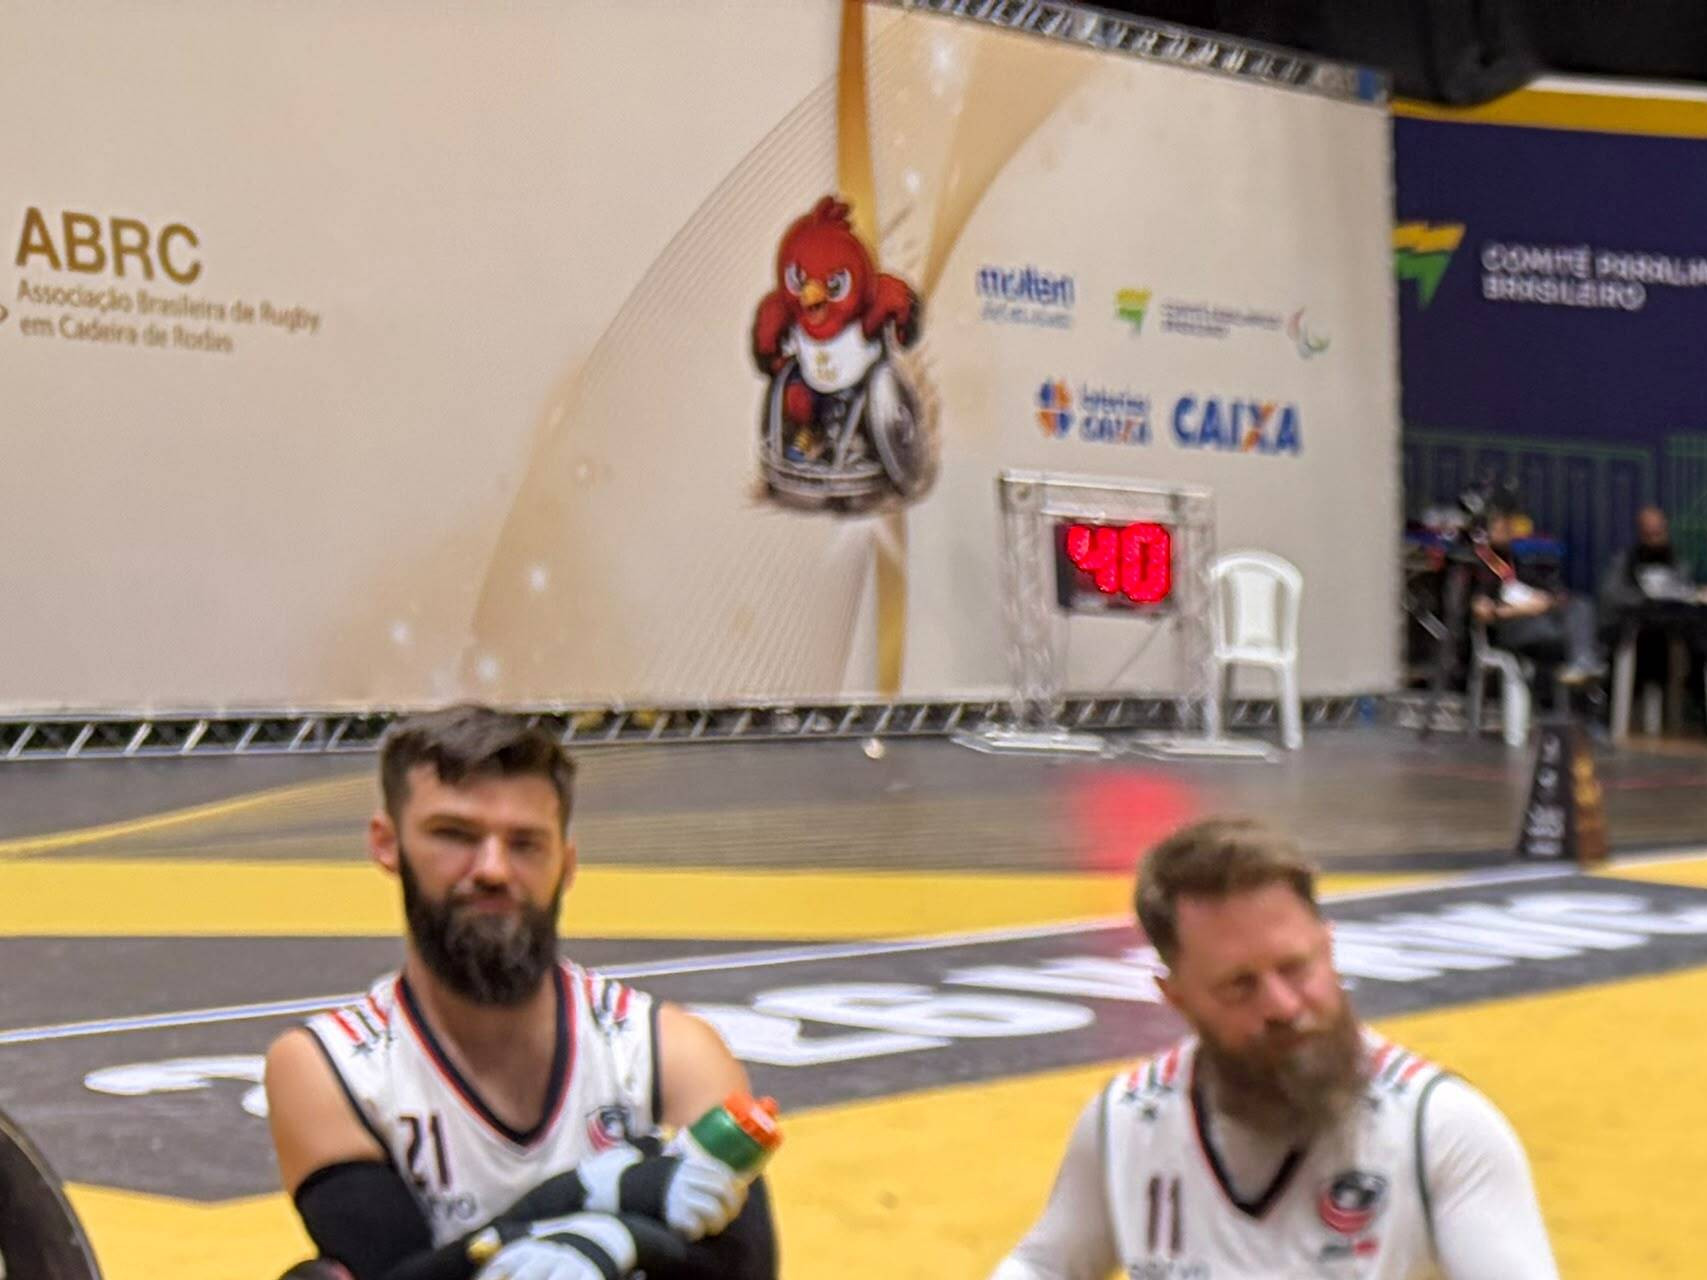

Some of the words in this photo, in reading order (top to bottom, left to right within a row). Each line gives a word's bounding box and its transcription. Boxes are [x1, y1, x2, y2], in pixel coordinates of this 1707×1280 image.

[15, 206, 203, 285] ABRC
[1172, 395, 1303, 454] CAIXA
[1066, 522, 1171, 603] 40
[398, 1113, 453, 1190] 21
[1146, 1175, 1182, 1259] 11
